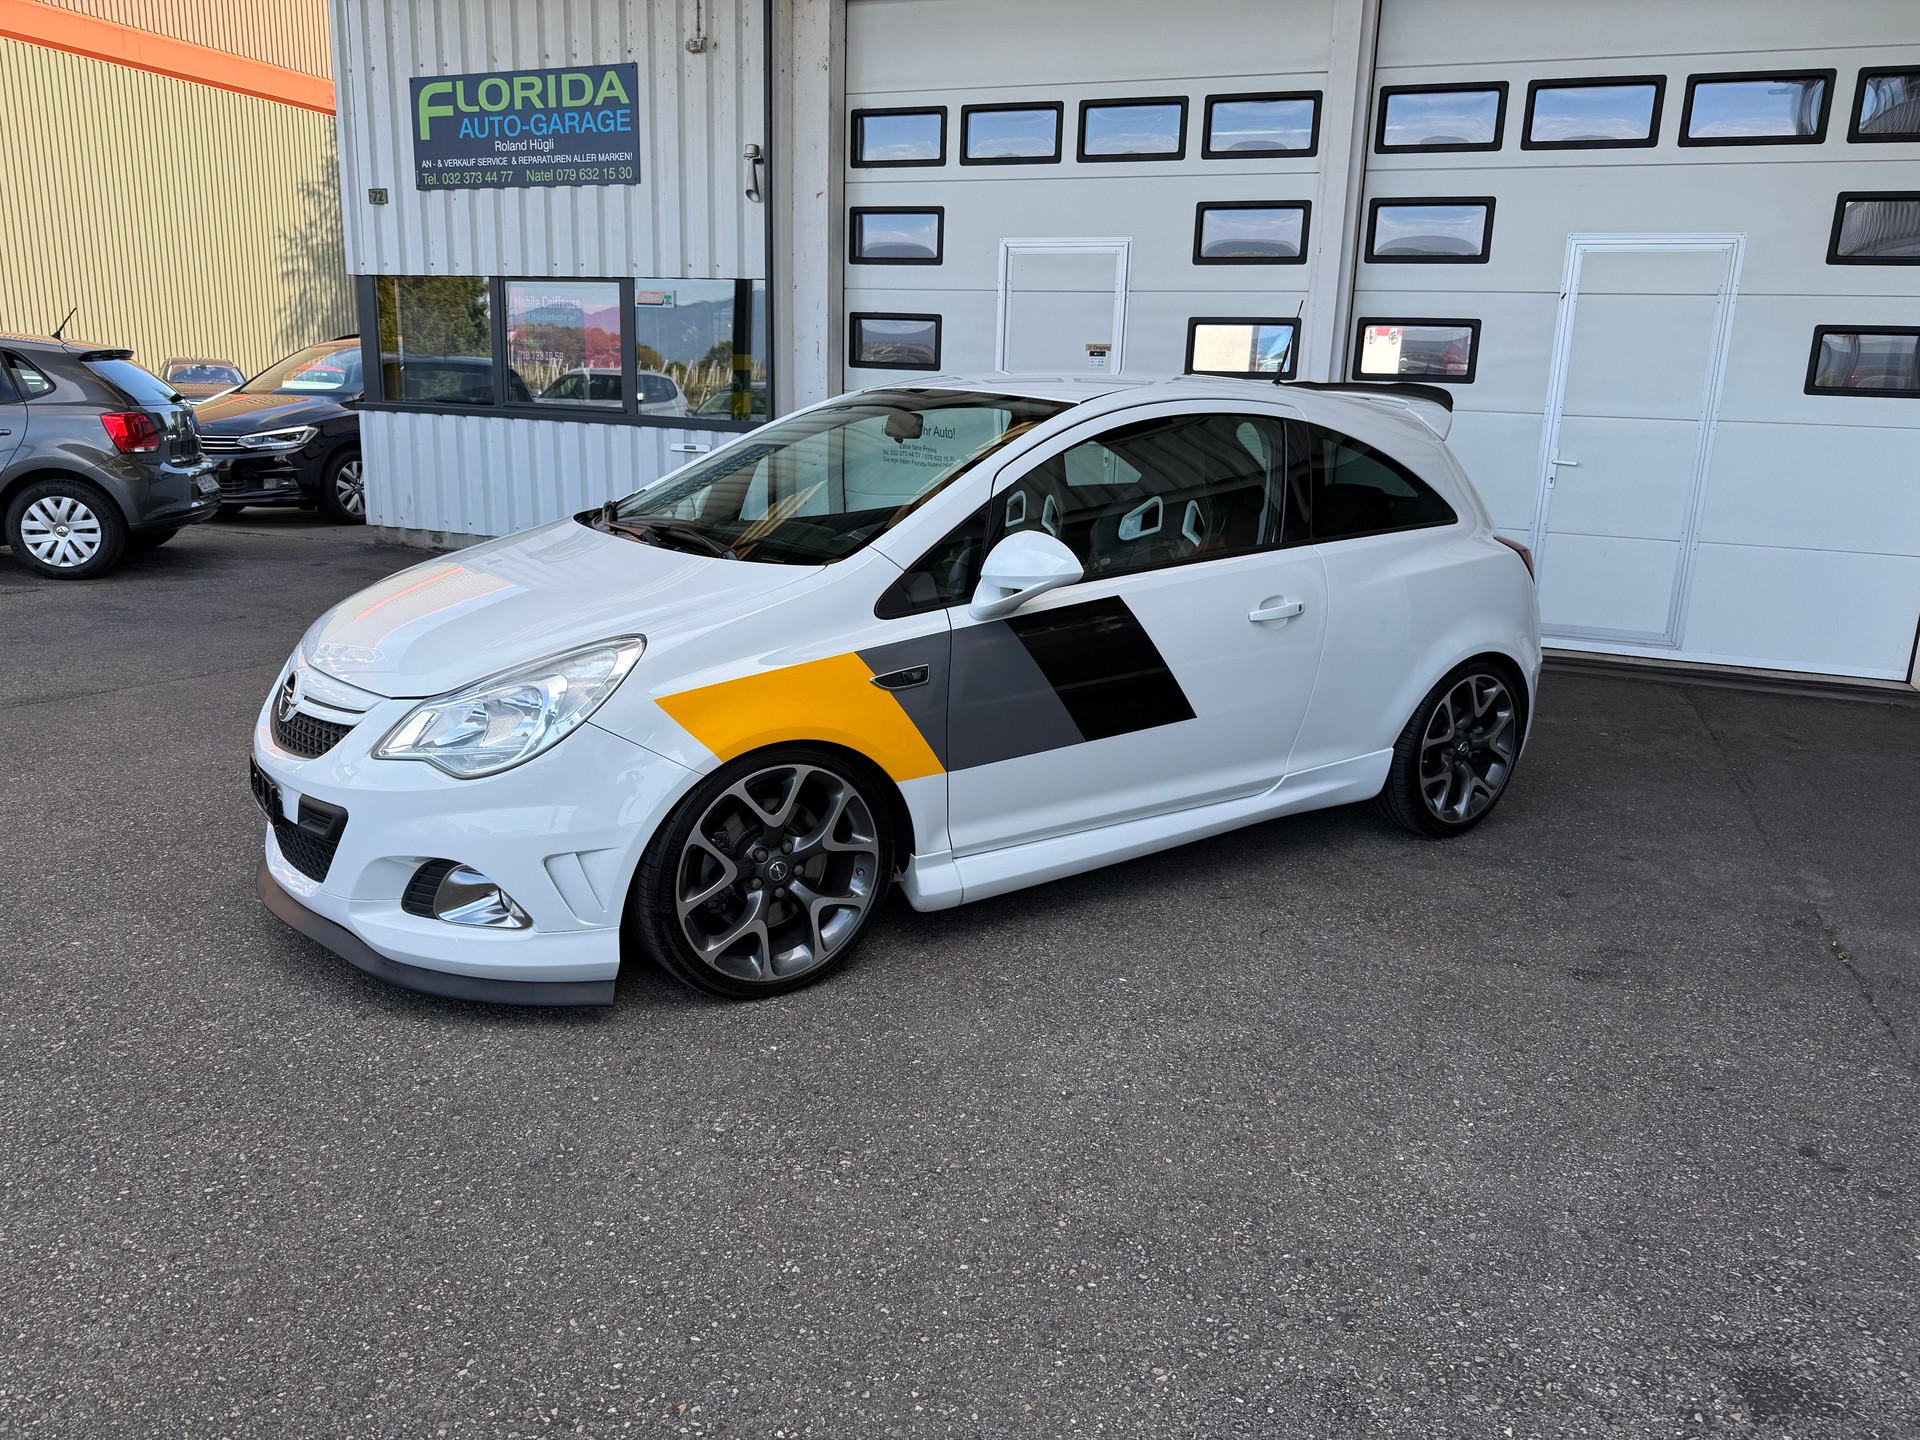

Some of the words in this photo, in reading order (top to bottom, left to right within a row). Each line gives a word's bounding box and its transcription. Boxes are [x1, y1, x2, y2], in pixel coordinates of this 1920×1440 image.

[418, 70, 630, 140] FLORIDA
[459, 109, 632, 139] AUTO-GARAGE
[494, 140, 527, 152] Roland
[529, 138, 555, 152] Hügli
[421, 160, 432, 168] AN
[437, 160, 443, 168] &
[443, 158, 476, 167] VERKAUF
[477, 156, 508, 166] SERVICE
[511, 156, 517, 165] &
[518, 154, 572, 165] REPARATUREN
[573, 153, 597, 162] ALLER
[598, 152, 633, 161] MARKEN!
[422, 172, 439, 185] Tel.
[442, 172, 461, 184] 032
[463, 171, 482, 184] 373
[485, 171, 498, 183] 44
[500, 171, 513, 182] 77
[526, 169, 554, 182] Natel
[556, 168, 576, 181] 079
[579, 168, 599, 180] 632
[603, 167, 616, 179] 15
[618, 166, 632, 179] 30
[372, 190, 384, 202] 72
[514, 294, 540, 308] Mobile
[541, 295, 581, 309] Coiffeuse
[933, 426, 956, 440] Auto!
